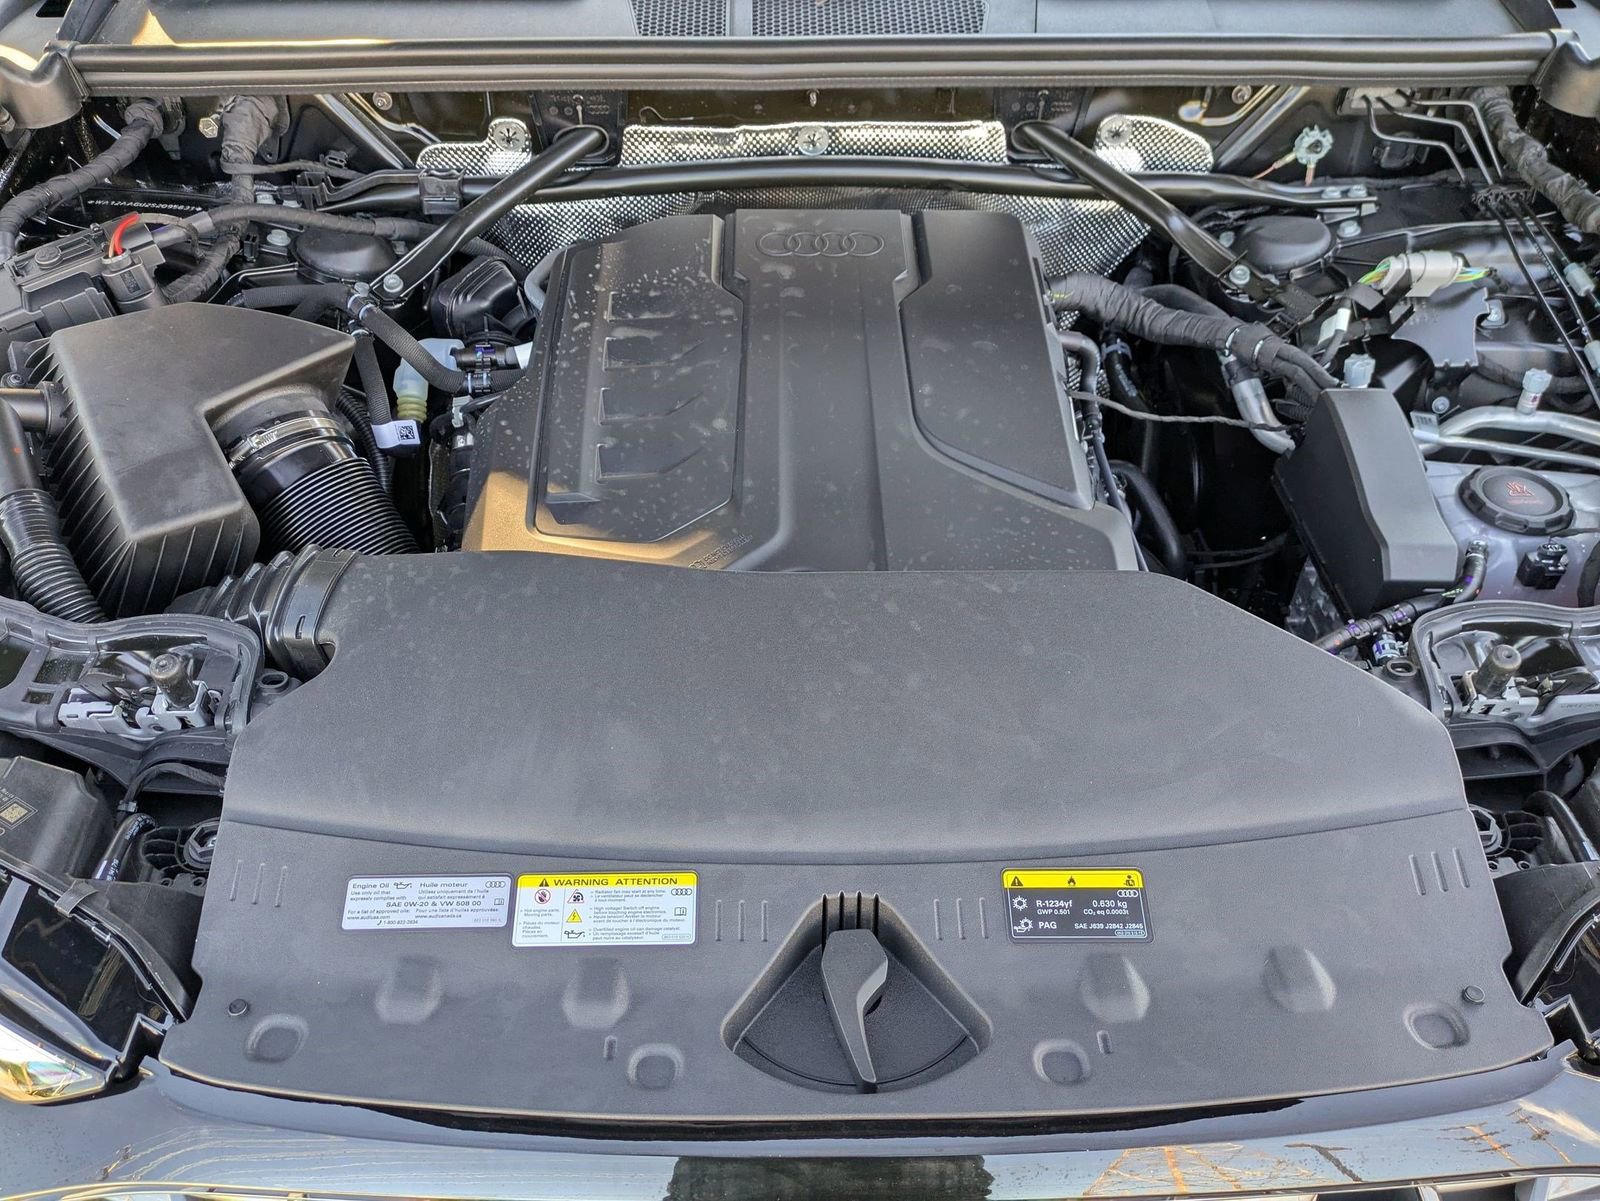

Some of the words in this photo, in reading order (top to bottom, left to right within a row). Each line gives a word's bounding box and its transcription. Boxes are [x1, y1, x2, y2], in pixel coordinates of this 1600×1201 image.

[616, 878, 678, 886] ATTENTION
[1036, 900, 1073, 908] R-1234yf
[1117, 900, 1128, 908] kg
